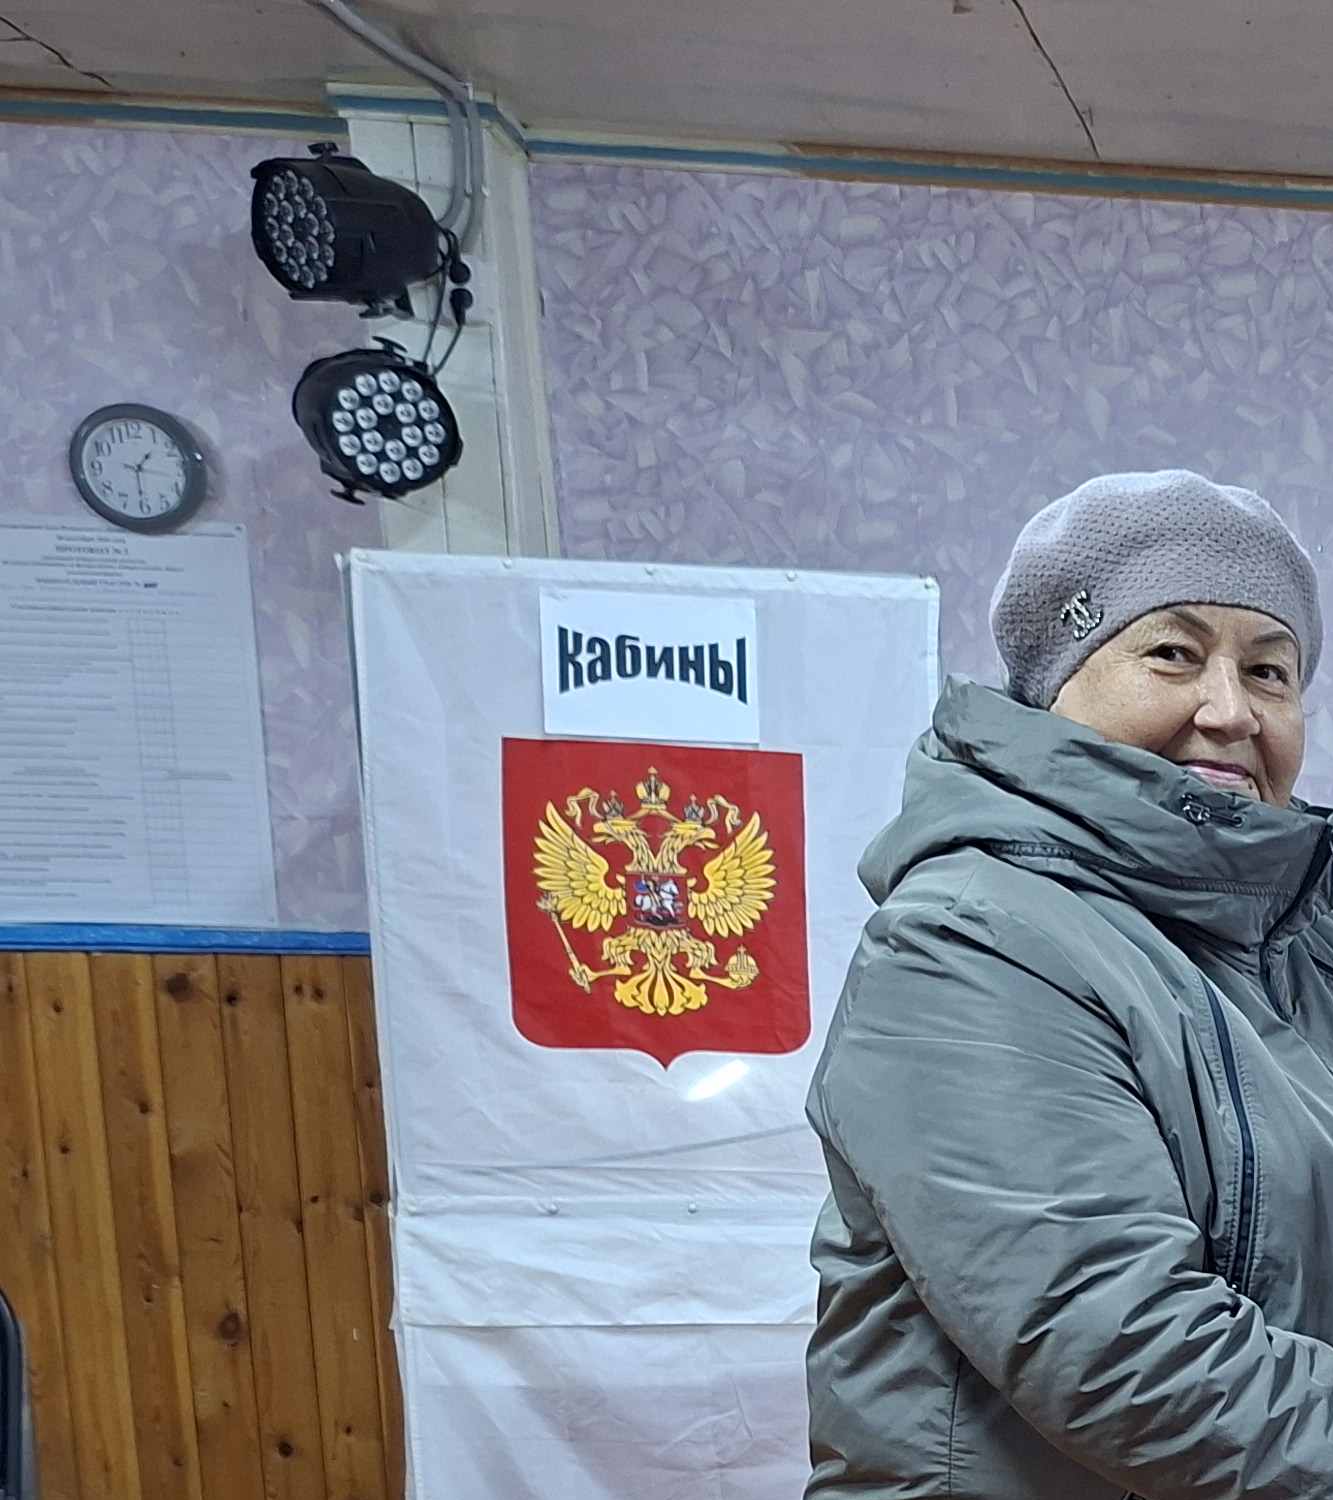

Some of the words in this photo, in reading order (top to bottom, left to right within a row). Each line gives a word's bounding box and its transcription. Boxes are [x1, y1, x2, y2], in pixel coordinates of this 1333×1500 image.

[110, 427, 123, 444] 11
[125, 422, 142, 439] 12
[94, 441, 112, 457] 10
[164, 440, 178, 458] 2
[90, 460, 103, 476] 9
[118, 492, 129, 510] 7
[139, 498, 151, 515] 6
[557, 624, 748, 706] Кабины
